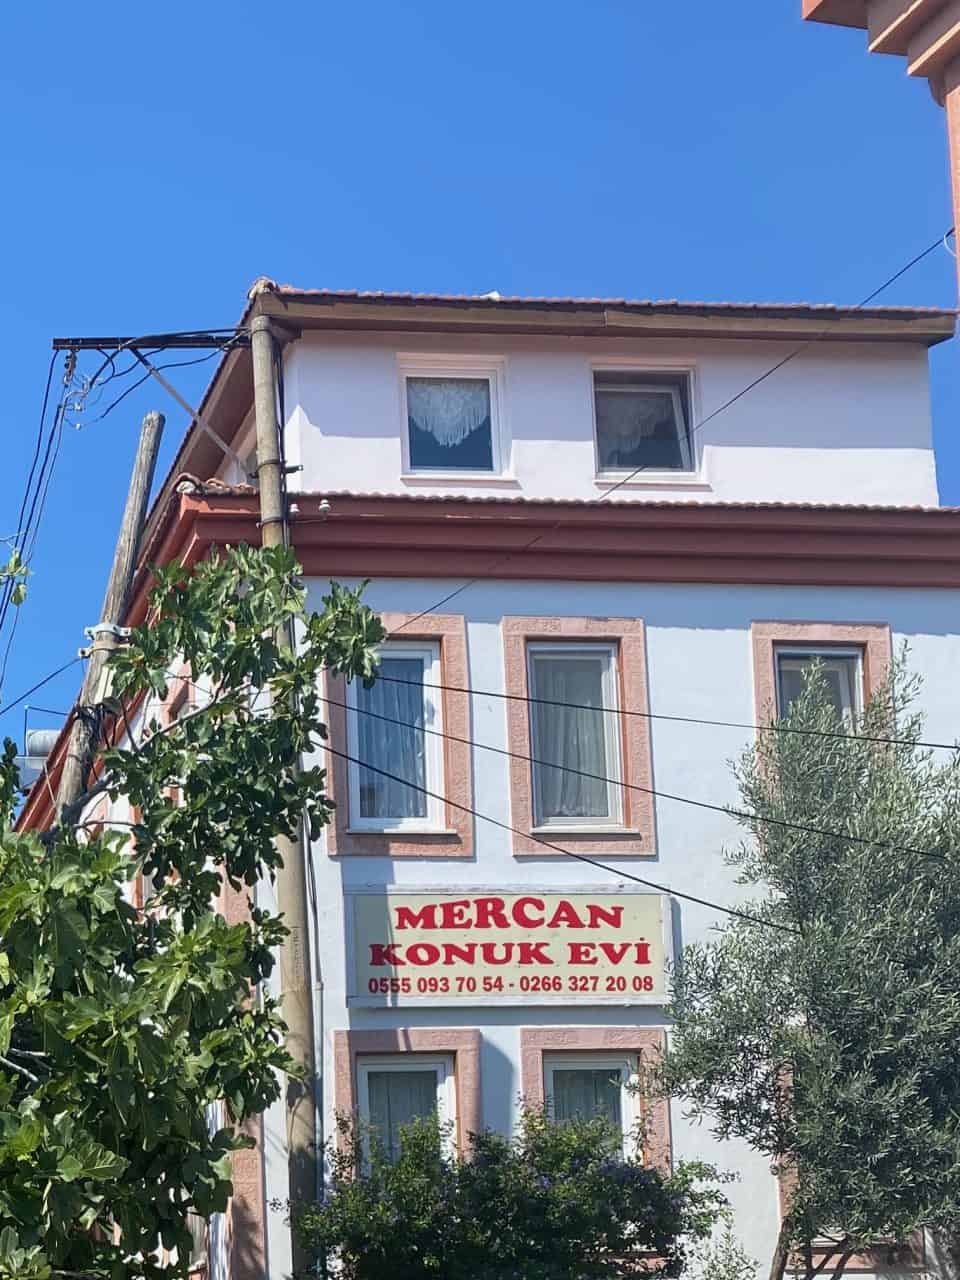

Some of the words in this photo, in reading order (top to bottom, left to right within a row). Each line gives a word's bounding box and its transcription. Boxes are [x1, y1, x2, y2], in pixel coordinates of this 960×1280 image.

[395, 897, 624, 930] MERCAN
[369, 943, 554, 966] KONUK
[567, 937, 652, 965] EVİ
[368, 976, 411, 993] 0555
[417, 976, 450, 992] 093
[456, 976, 476, 992] 70
[482, 976, 504, 992] 54
[519, 975, 562, 991] 0266
[568, 975, 600, 991] 327
[605, 975, 627, 991] 20
[632, 975, 654, 991] 08
